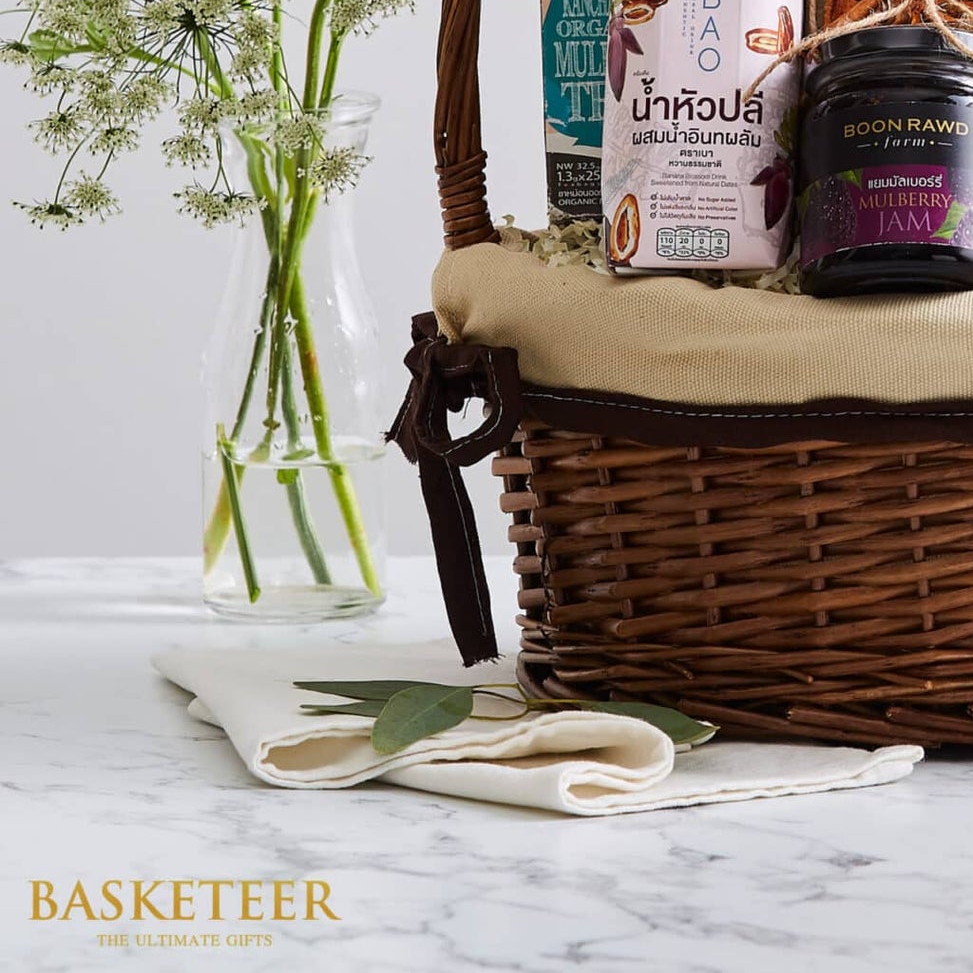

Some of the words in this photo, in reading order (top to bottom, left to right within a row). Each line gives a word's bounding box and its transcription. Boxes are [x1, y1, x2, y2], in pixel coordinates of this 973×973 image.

[843, 118, 902, 138] BOON
[907, 118, 970, 136] RAWD
[883, 136, 926, 150] farm
[679, 148, 714, 158] ตราเบา
[556, 162, 574, 171] NW
[668, 159, 722, 168] หวานธรรมชาติ
[558, 198, 598, 206] ORGANIC
[859, 192, 952, 210] MULBERRY
[878, 210, 934, 237] JAM
